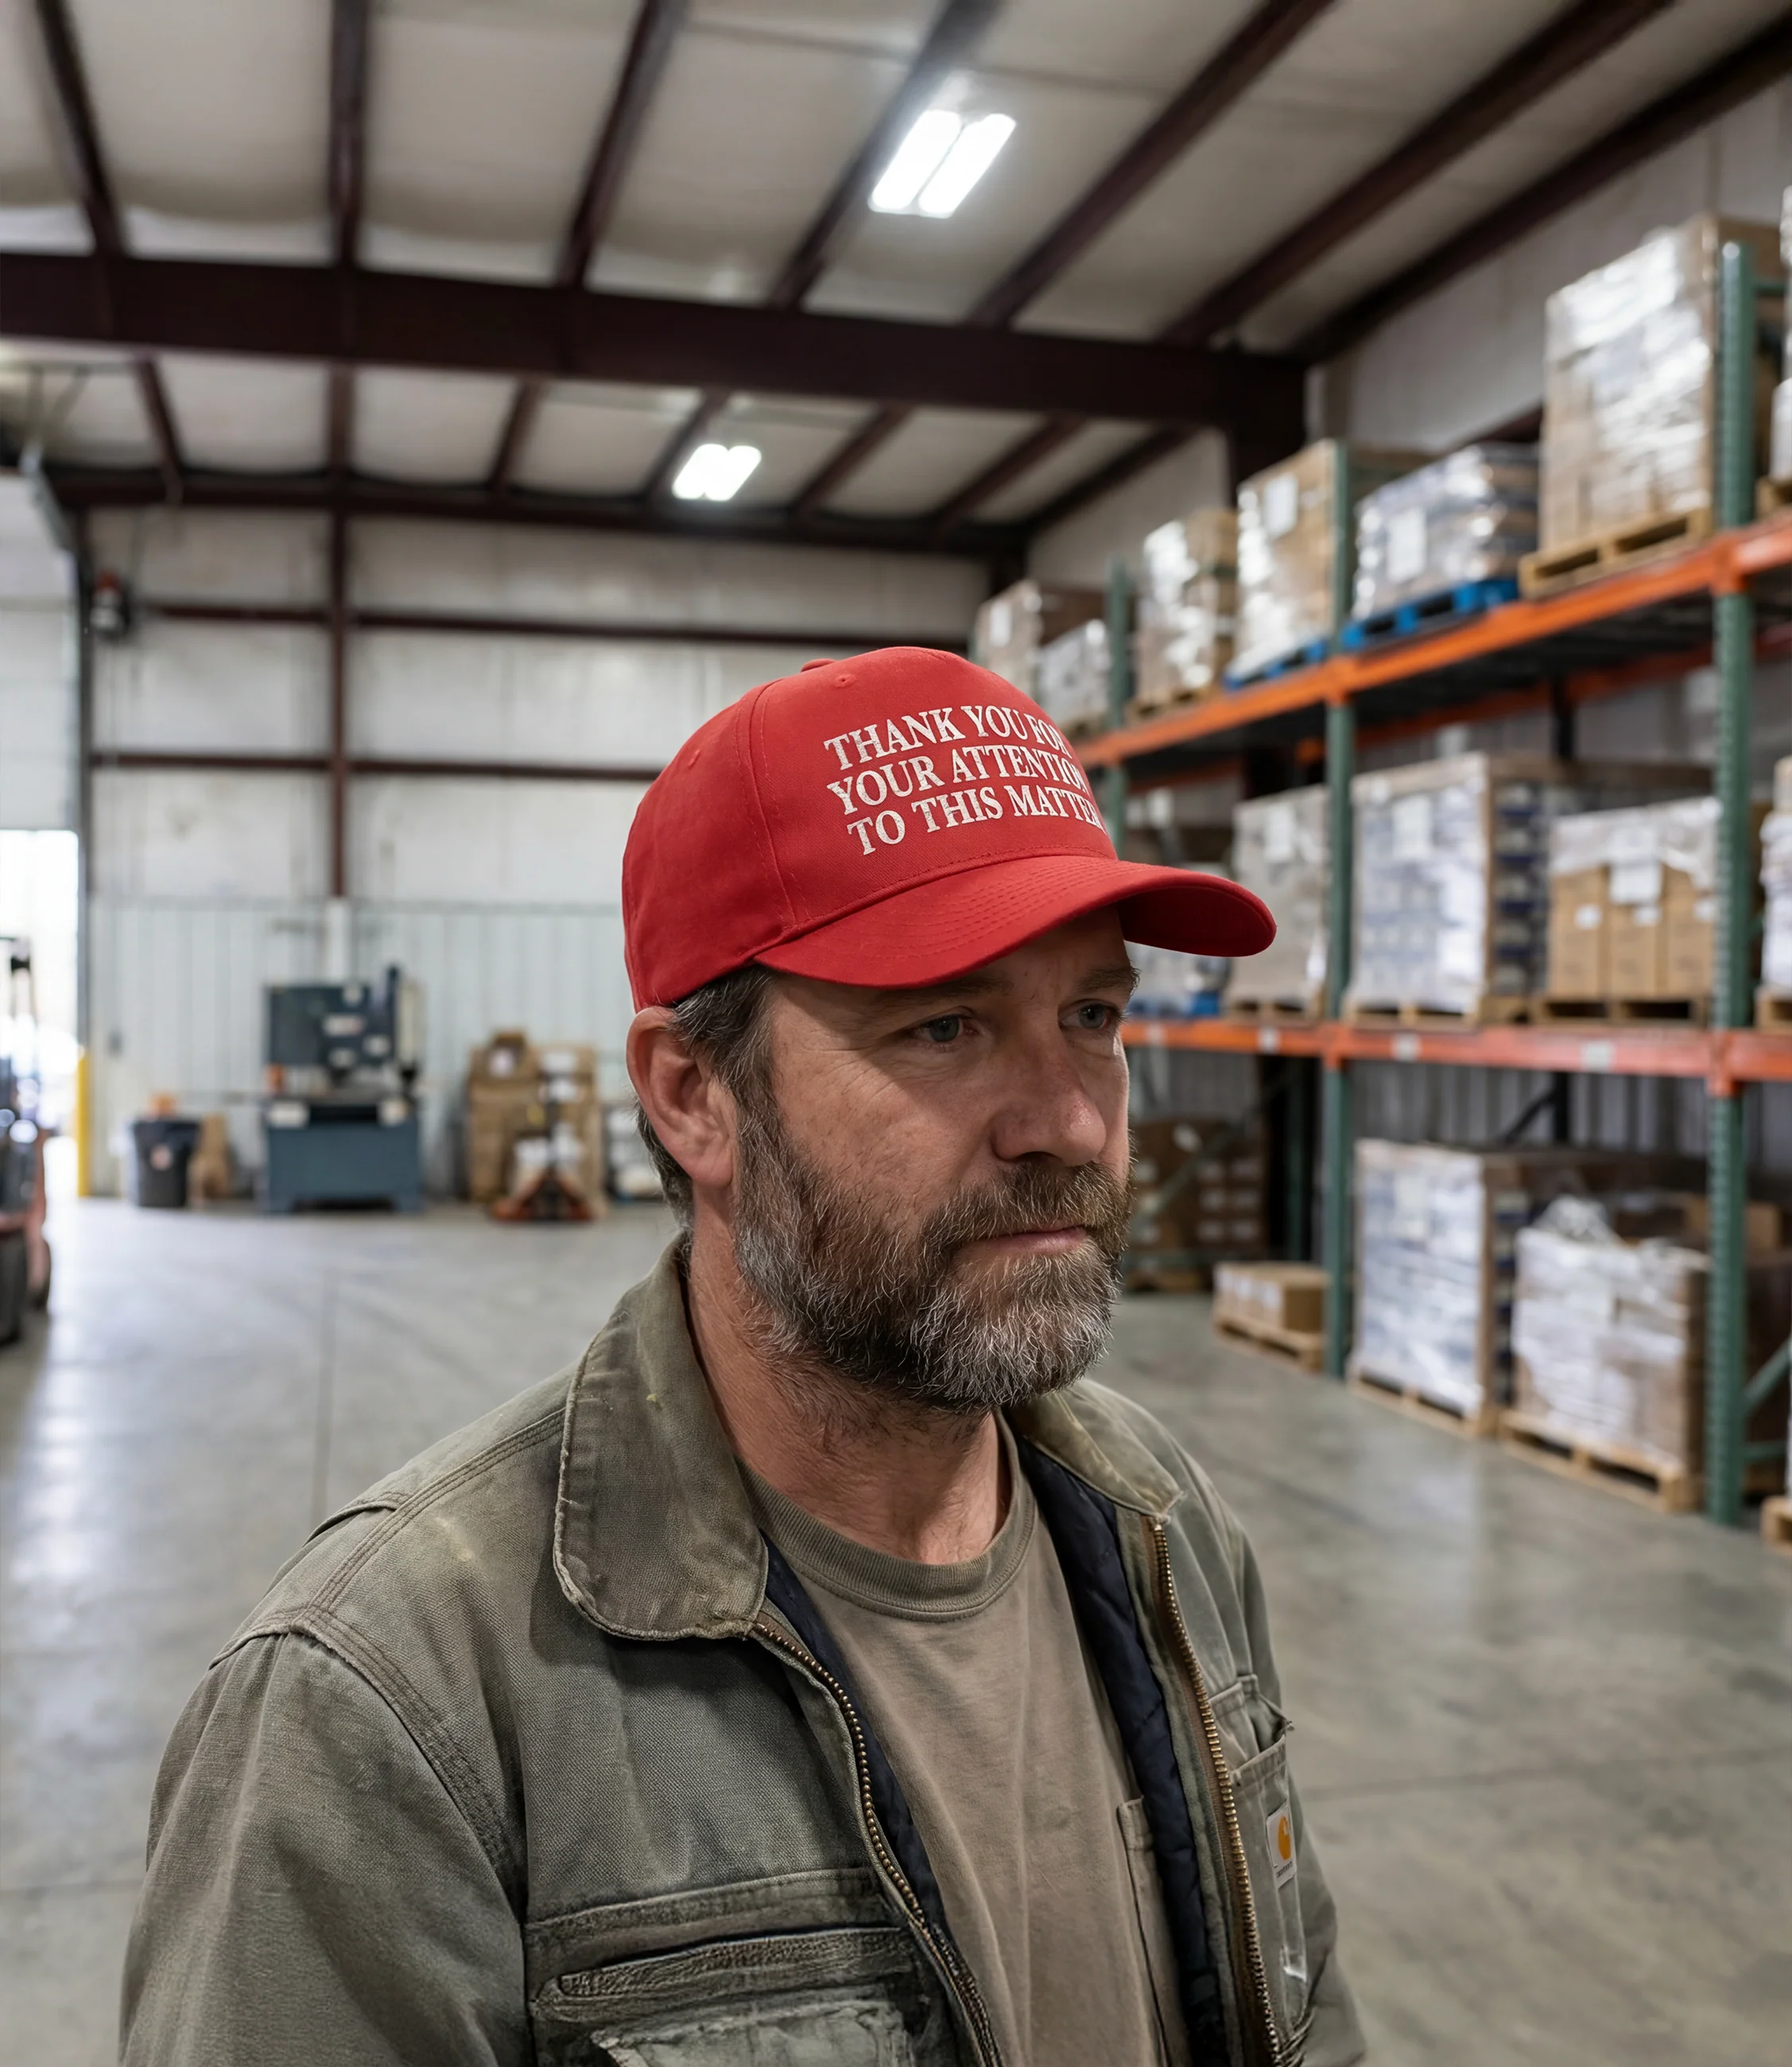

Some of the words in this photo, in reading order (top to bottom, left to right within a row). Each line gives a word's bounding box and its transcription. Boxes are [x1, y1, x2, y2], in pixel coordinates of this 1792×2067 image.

[824, 707, 966, 770] THANK
[961, 705, 1028, 739] YOU
[827, 756, 945, 815] YOUR
[848, 810, 906, 855] TO
[911, 786, 1003, 832] THIS
